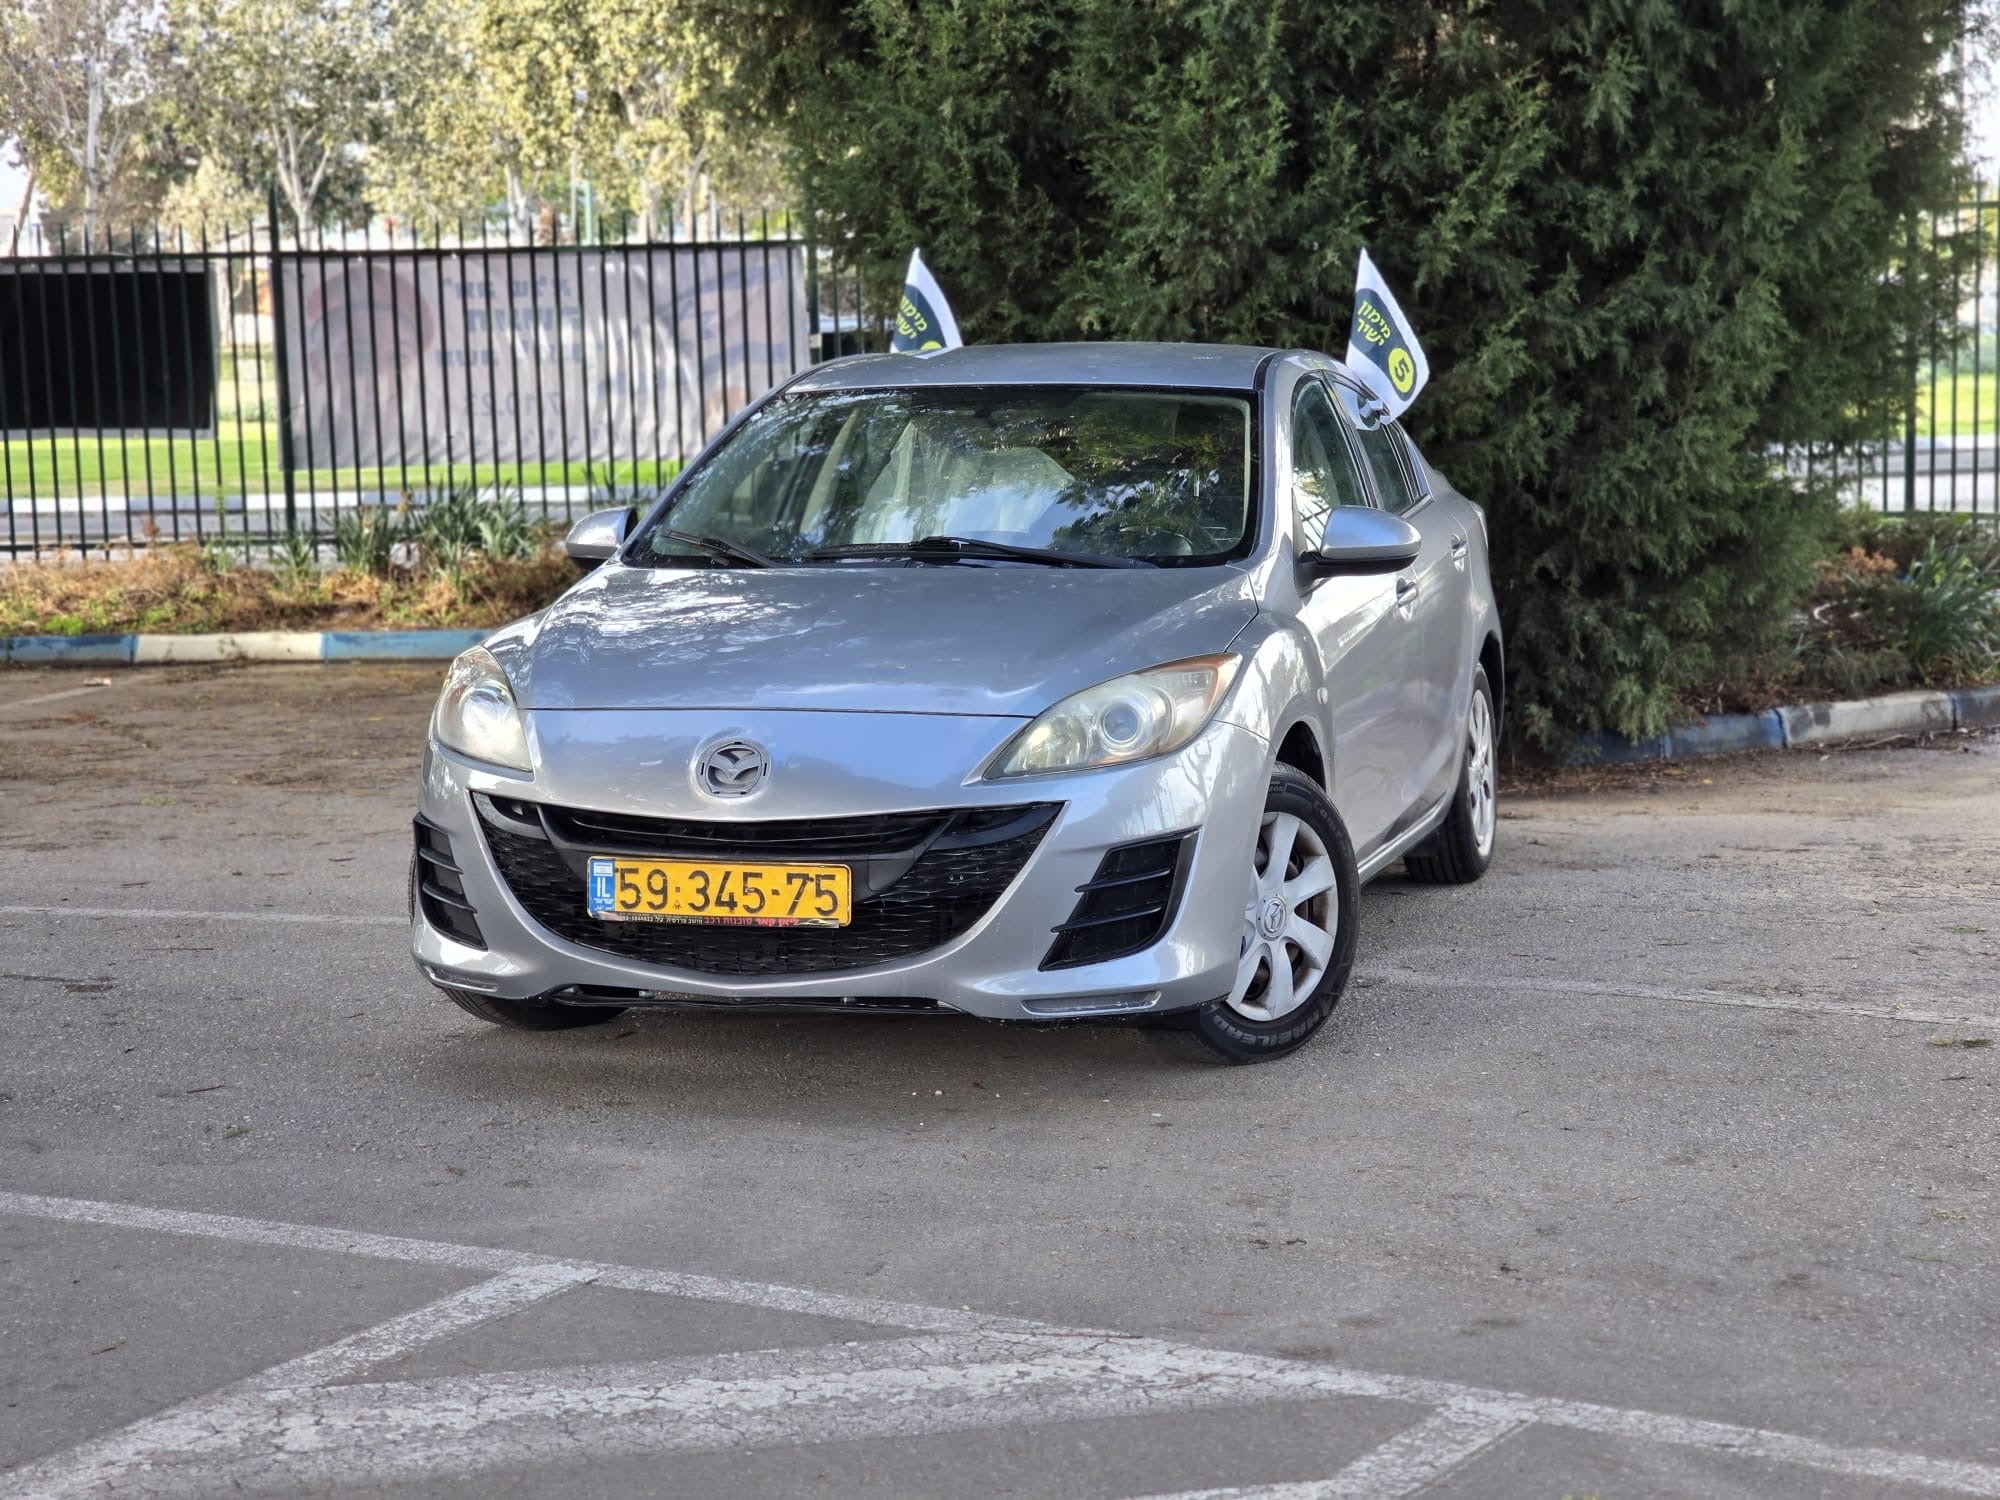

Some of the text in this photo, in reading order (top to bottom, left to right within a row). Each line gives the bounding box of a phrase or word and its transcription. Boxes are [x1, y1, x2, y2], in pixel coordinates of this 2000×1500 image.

[1357, 300, 1391, 339] מימון
[1357, 318, 1385, 346] ישיר
[1394, 358, 1410, 383] 5
[597, 877, 610, 897] IL
[703, 916, 721, 925] רכב
[723, 917, 753, 926] סוכנות
